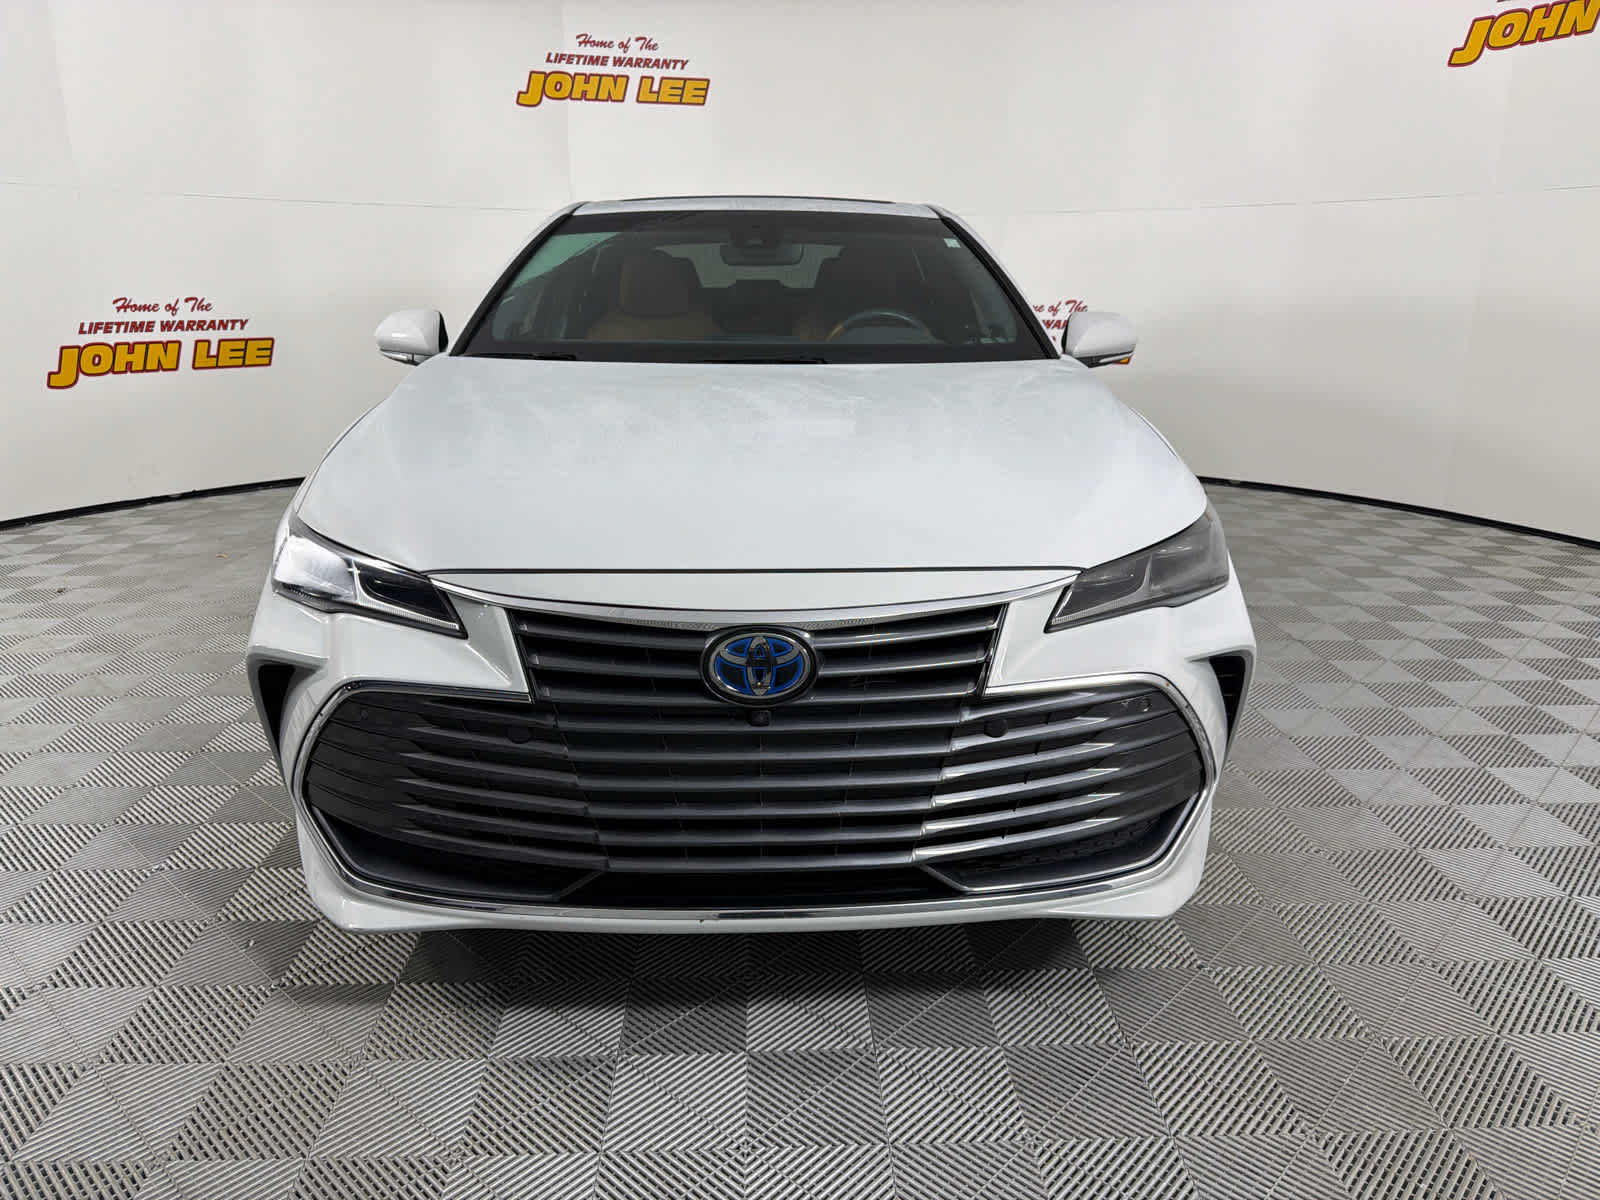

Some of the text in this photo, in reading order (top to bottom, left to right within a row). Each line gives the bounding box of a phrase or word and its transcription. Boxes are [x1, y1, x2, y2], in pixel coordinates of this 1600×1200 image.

[1448, 0, 1600, 67] JOHN
[576, 34, 659, 52] Home of The
[545, 53, 689, 70] LIFETIME WARRANTY
[516, 70, 710, 107] JOHN LEE
[112, 297, 213, 316] Home of The
[1047, 300, 1061, 316] of
[1065, 299, 1089, 313] The
[78, 319, 249, 335] LIFETIME WARRANTY
[47, 337, 275, 389] JOHN LEE
